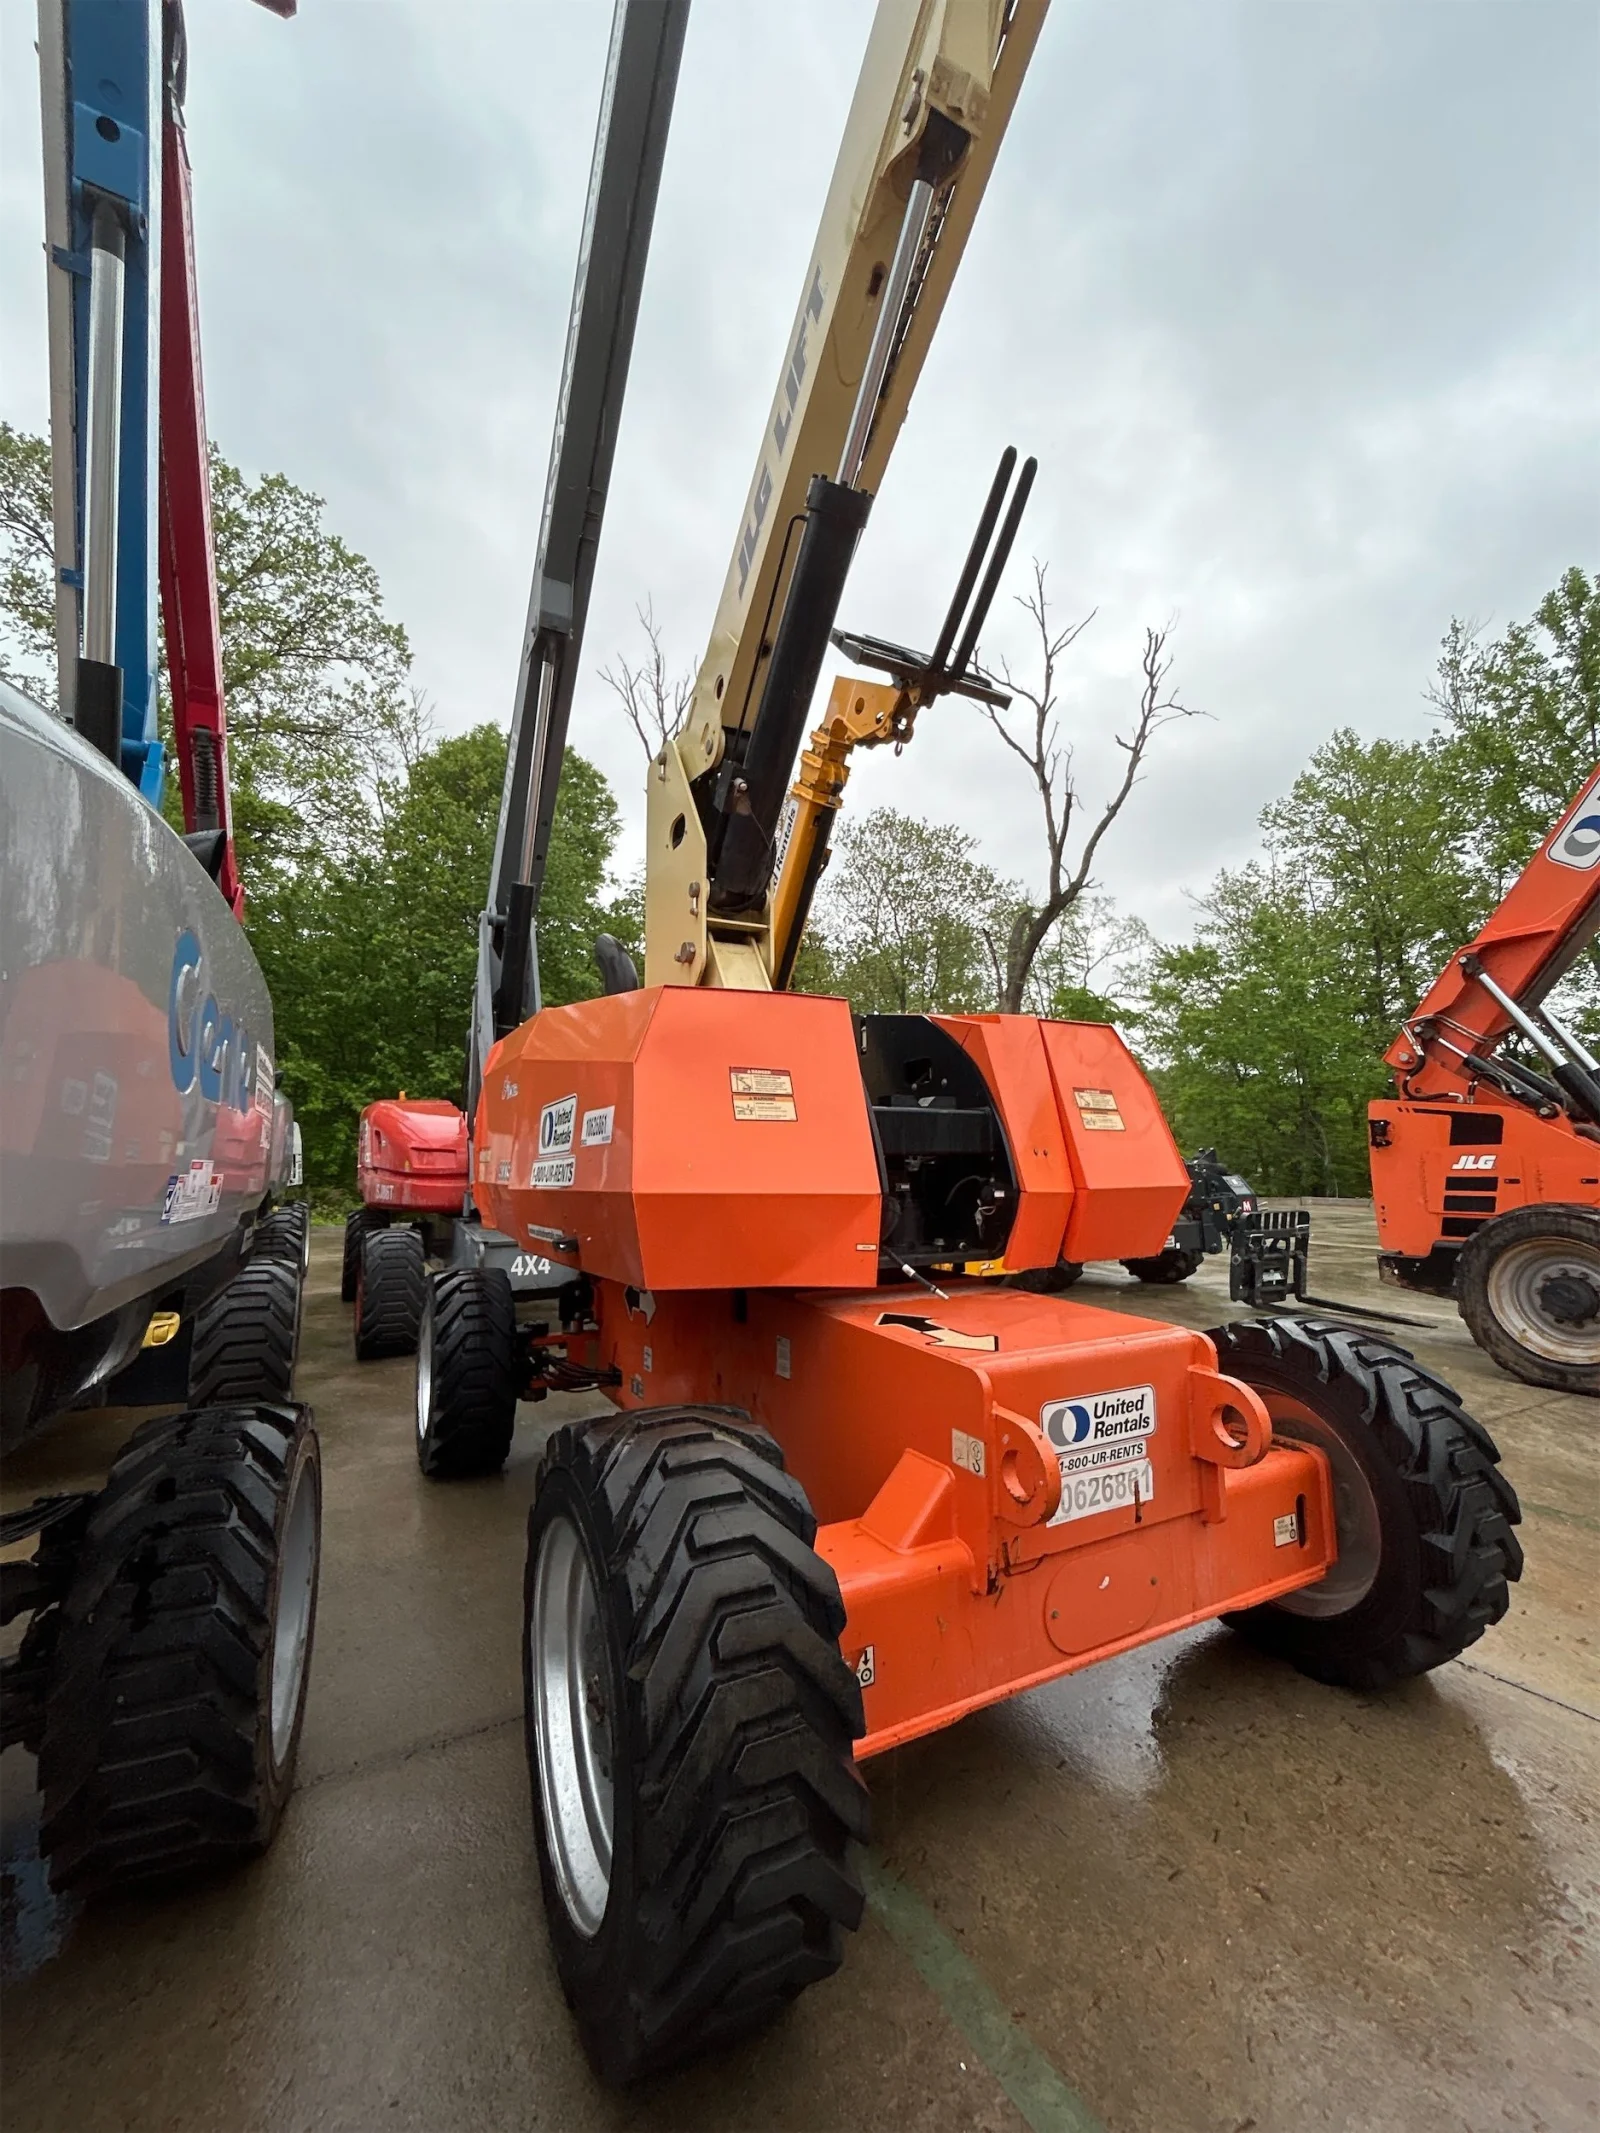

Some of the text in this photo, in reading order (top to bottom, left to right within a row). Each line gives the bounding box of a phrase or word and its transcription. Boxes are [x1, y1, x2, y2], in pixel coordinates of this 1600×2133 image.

[540, 275, 587, 551] SKYJACK
[738, 264, 825, 600] JLG LIFT
[774, 806, 797, 871] Rentals
[170, 927, 249, 1114] Genie
[554, 1105, 574, 1127] United
[551, 1125, 572, 1148] Rentals
[532, 1161, 575, 1184] 1-800-UR-RENTS
[1451, 1155, 1497, 1170] JLG
[510, 1254, 551, 1276] 4X4
[1093, 1394, 1145, 1419] United
[1093, 1415, 1151, 1440] Rentals
[1059, 1442, 1144, 1472] 1-800-UR-RENTS
[1060, 1464, 1151, 1515] 0626861
